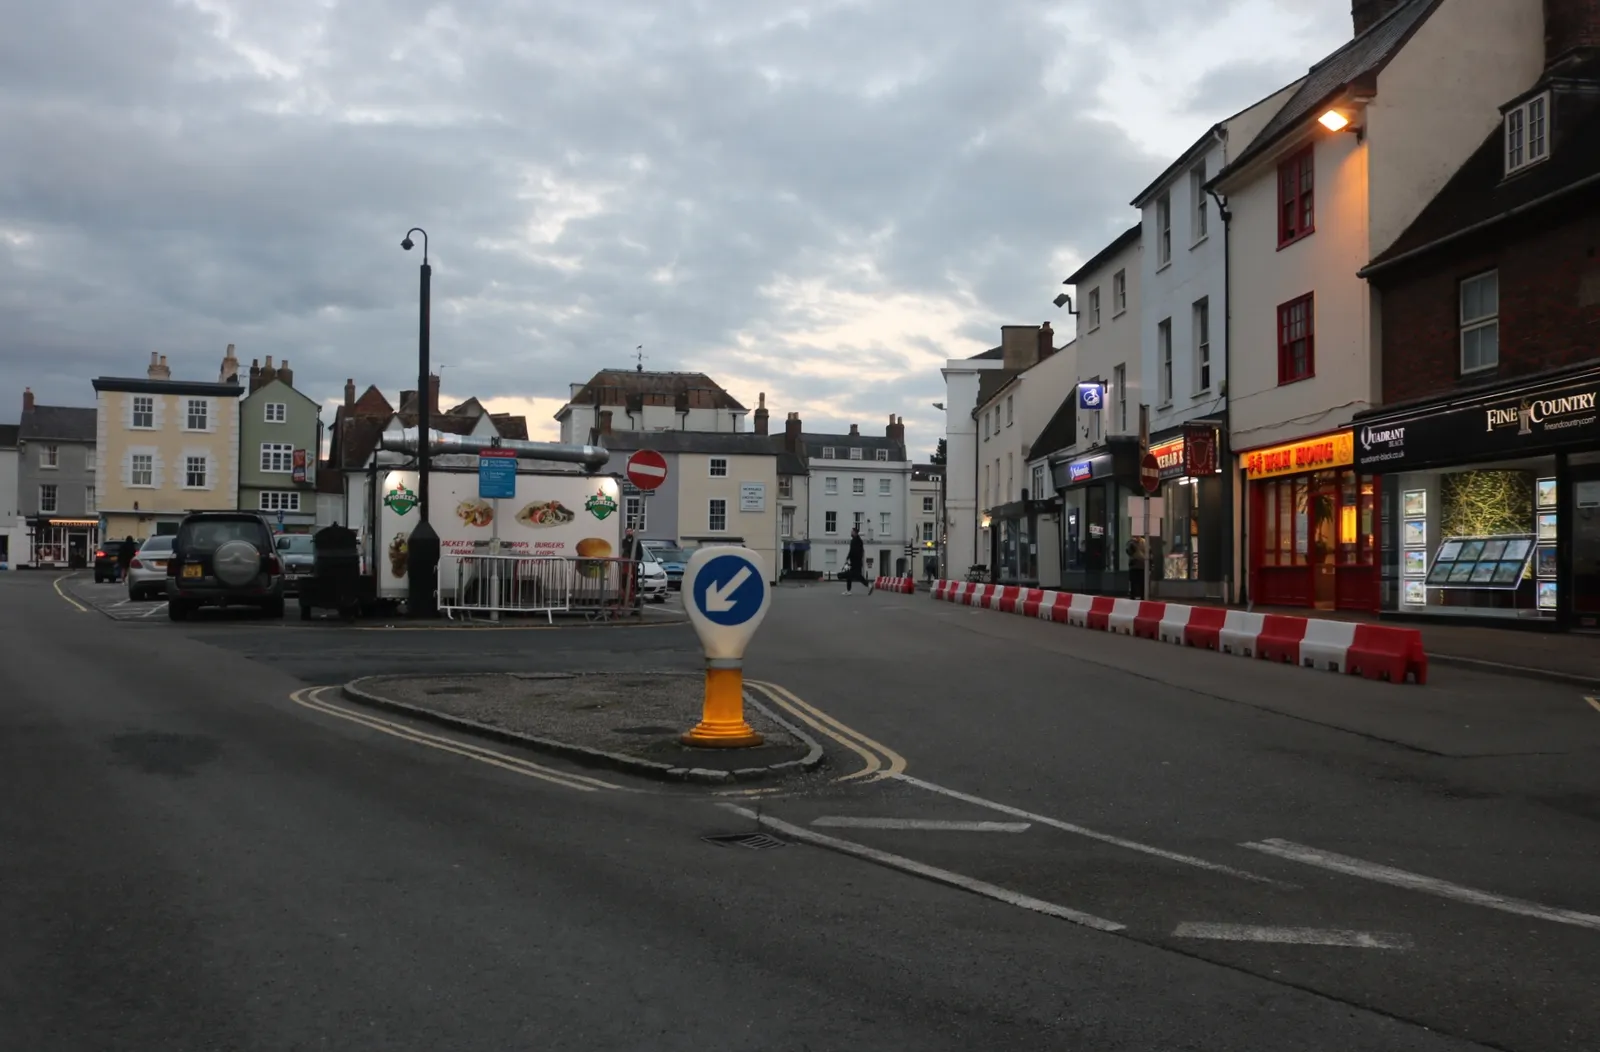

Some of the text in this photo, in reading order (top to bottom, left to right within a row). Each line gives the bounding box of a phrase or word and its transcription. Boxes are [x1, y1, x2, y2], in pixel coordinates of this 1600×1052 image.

[1486, 407, 1518, 432] FINE
[1530, 392, 1597, 423] COUNTRY
[1360, 425, 1406, 451] QUADRANT
[1156, 451, 1178, 469] KEBAB
